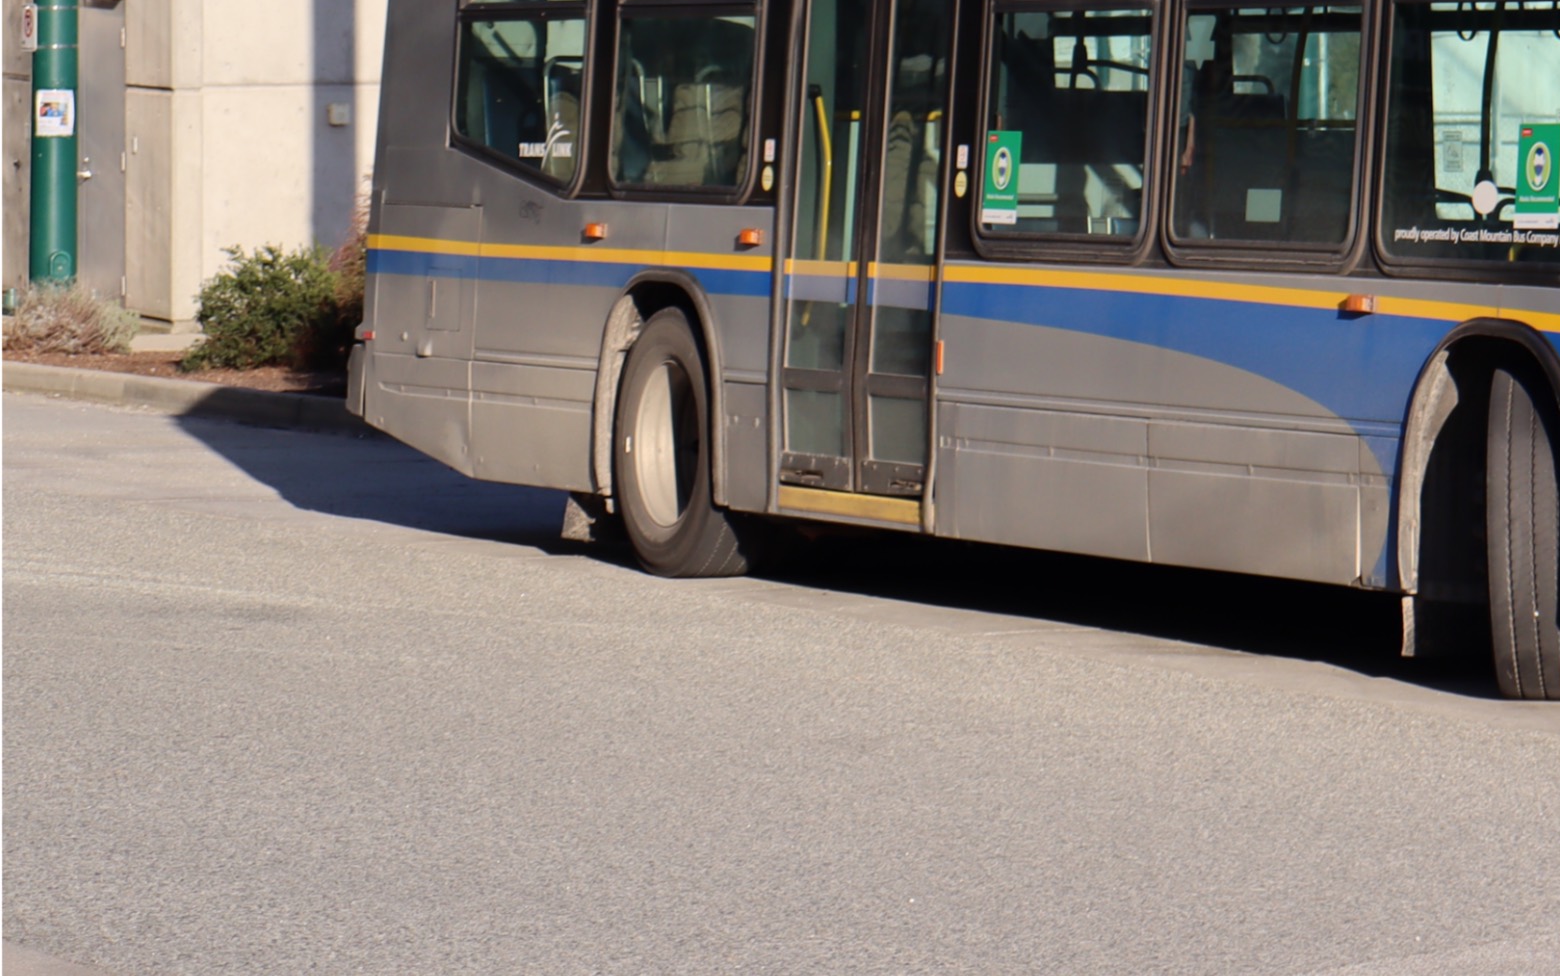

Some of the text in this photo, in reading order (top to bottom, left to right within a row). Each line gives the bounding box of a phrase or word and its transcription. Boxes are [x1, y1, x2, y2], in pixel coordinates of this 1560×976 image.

[1394, 226, 1420, 246] proudly
[1420, 227, 1450, 243] operated
[1450, 228, 1460, 244] by
[1460, 229, 1479, 242] Coast
[1480, 229, 1512, 243] Mountain
[1513, 230, 1526, 243] Bus
[1526, 231, 1559, 248] Company
